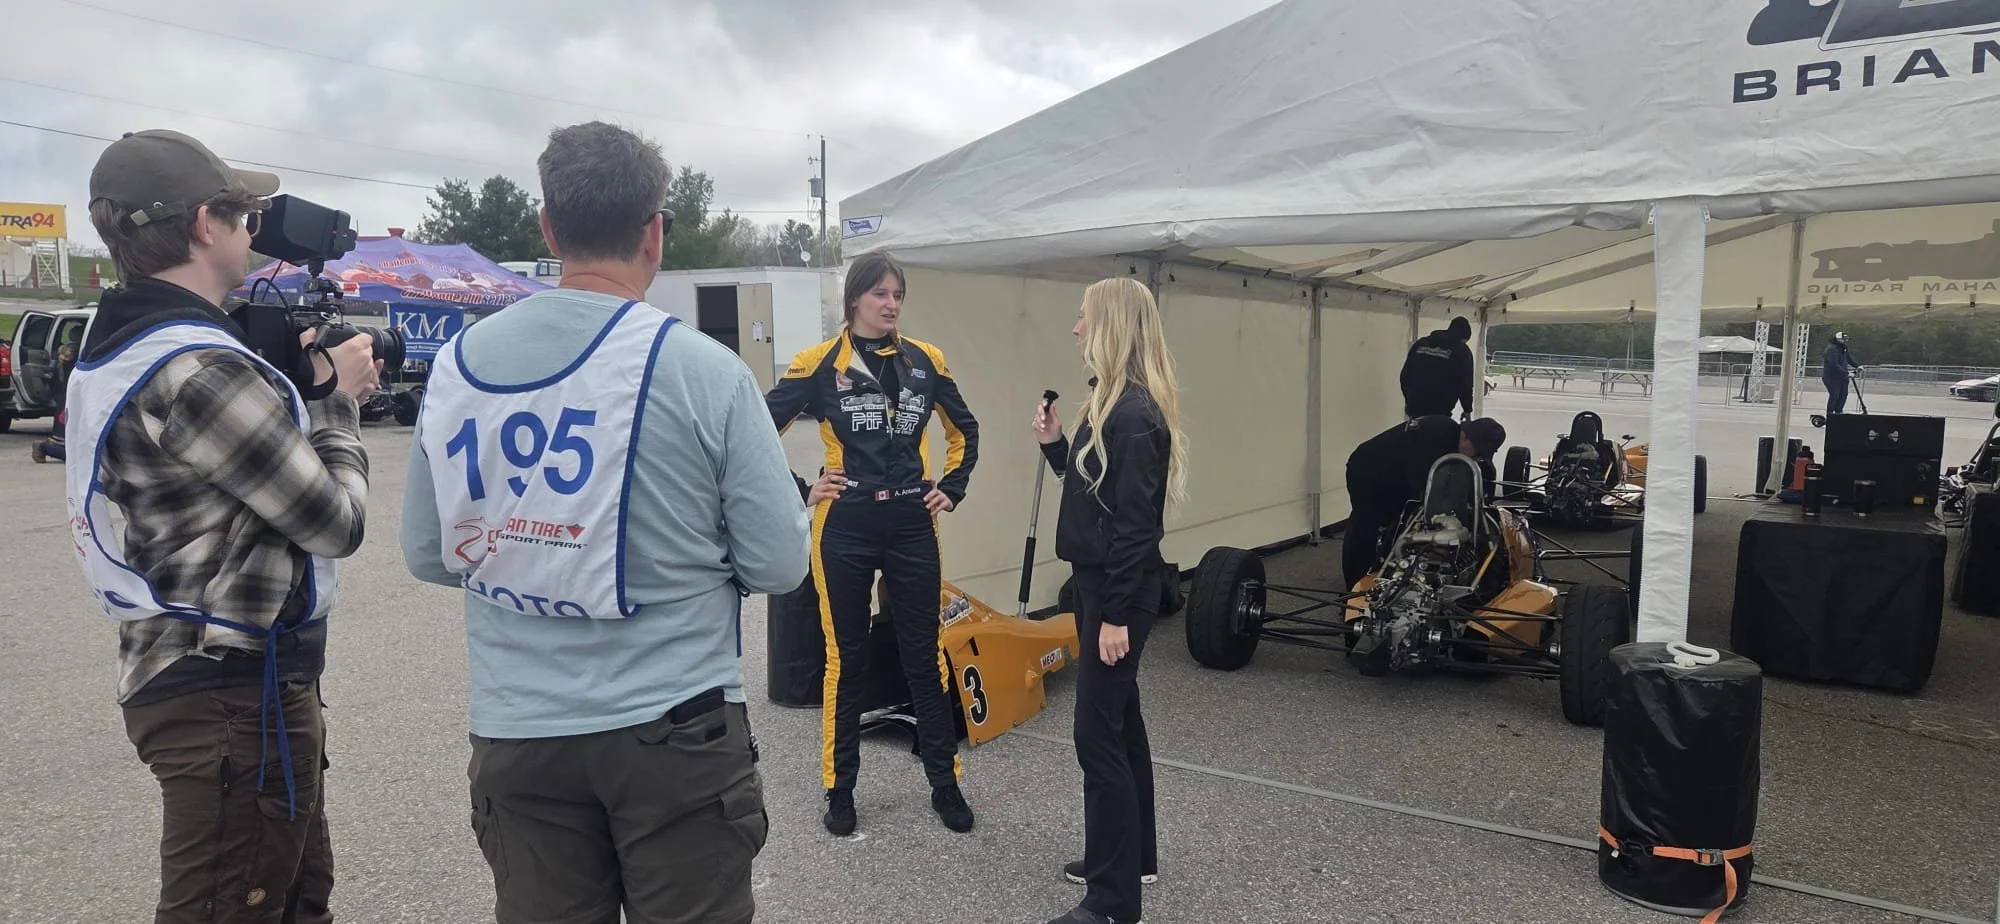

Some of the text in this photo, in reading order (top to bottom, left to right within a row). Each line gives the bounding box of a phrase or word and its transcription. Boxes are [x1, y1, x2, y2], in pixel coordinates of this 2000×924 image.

[0, 212, 55, 230] TRA94
[395, 311, 450, 340] KM
[446, 406, 597, 502] 195
[531, 520, 565, 538] TIRE
[544, 540, 583, 550] PARK
[963, 664, 989, 727] 3
